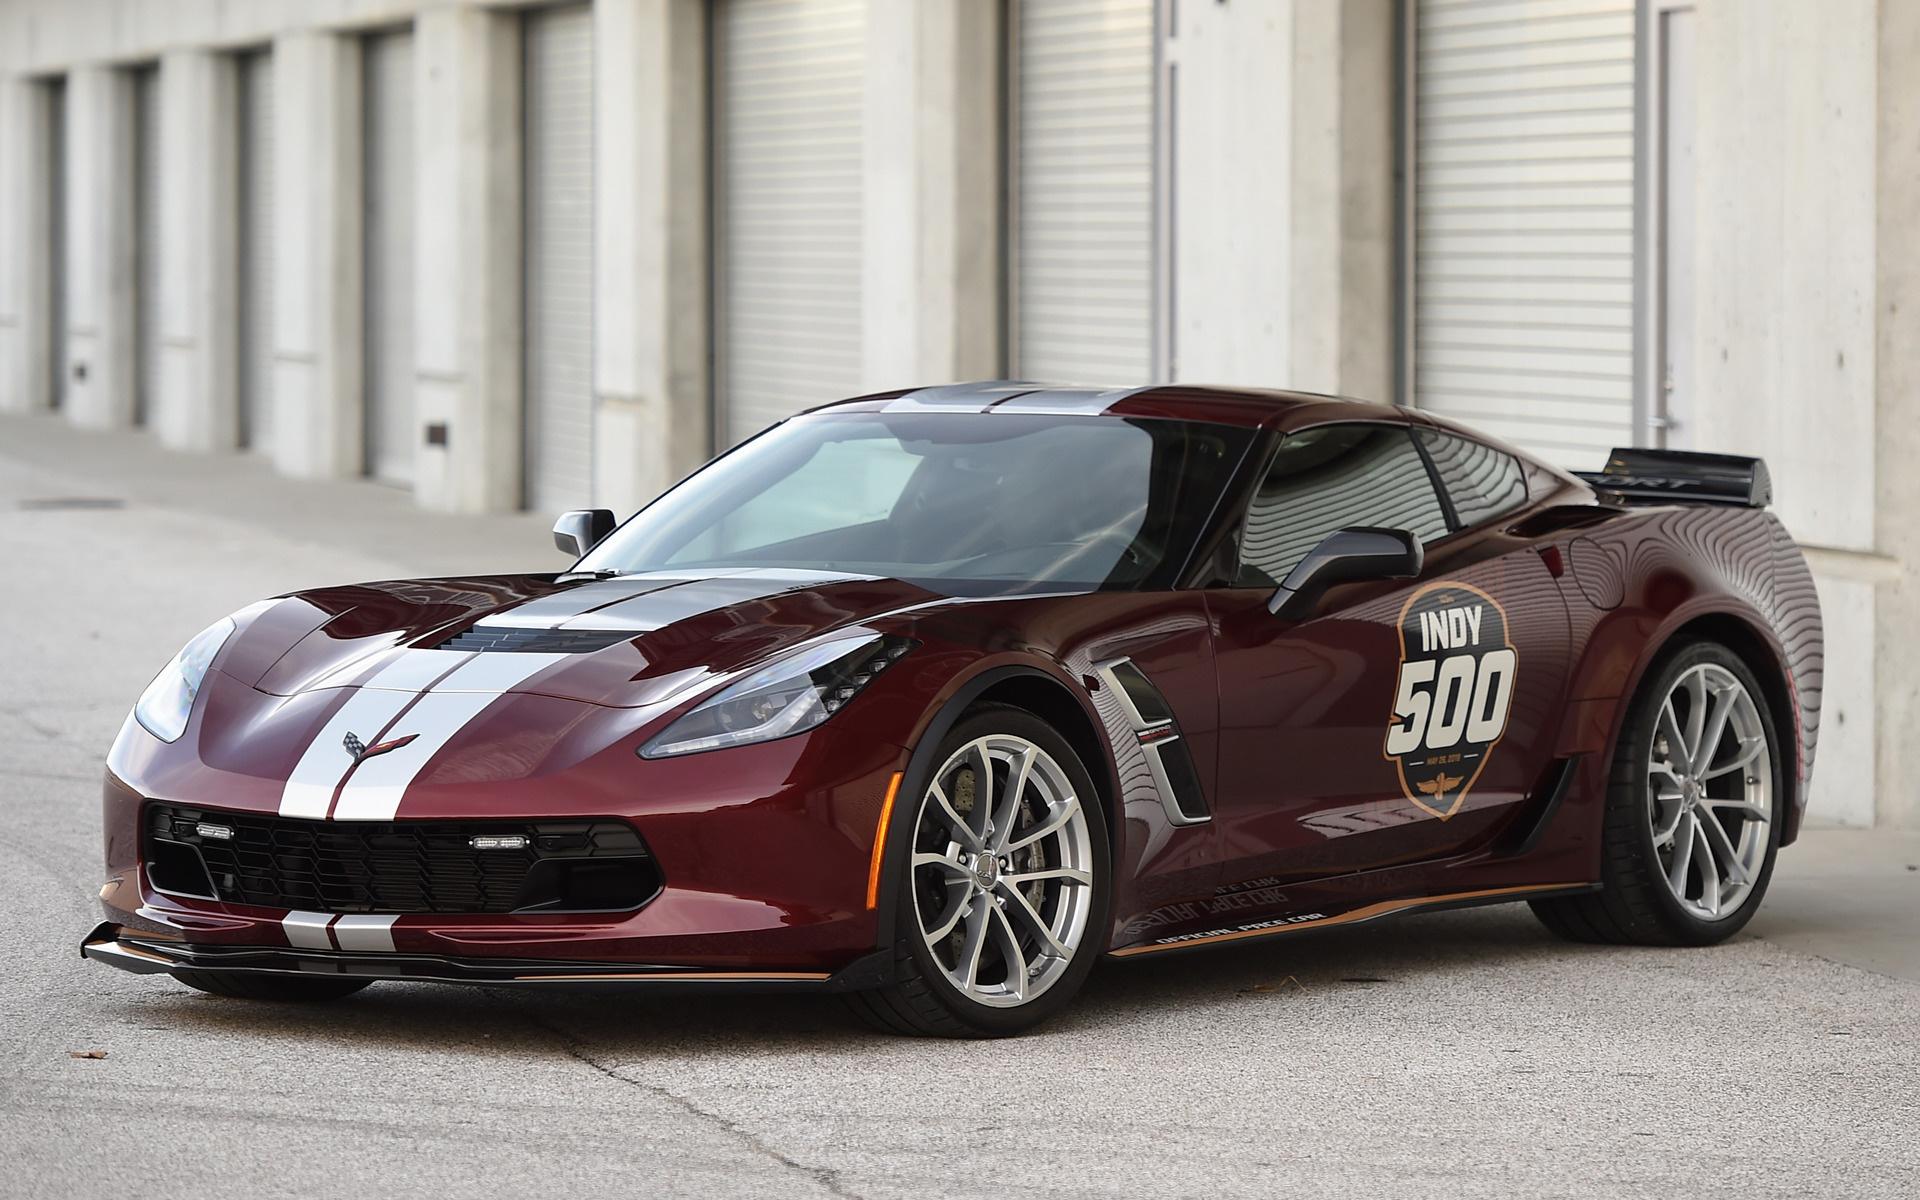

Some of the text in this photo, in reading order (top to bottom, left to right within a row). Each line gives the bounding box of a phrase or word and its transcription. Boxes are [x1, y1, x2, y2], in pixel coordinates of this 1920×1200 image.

[1420, 605, 1483, 652] INDY
[1386, 648, 1517, 756] 500
[1155, 912, 1328, 944] OFFICIAL PACE CAR
